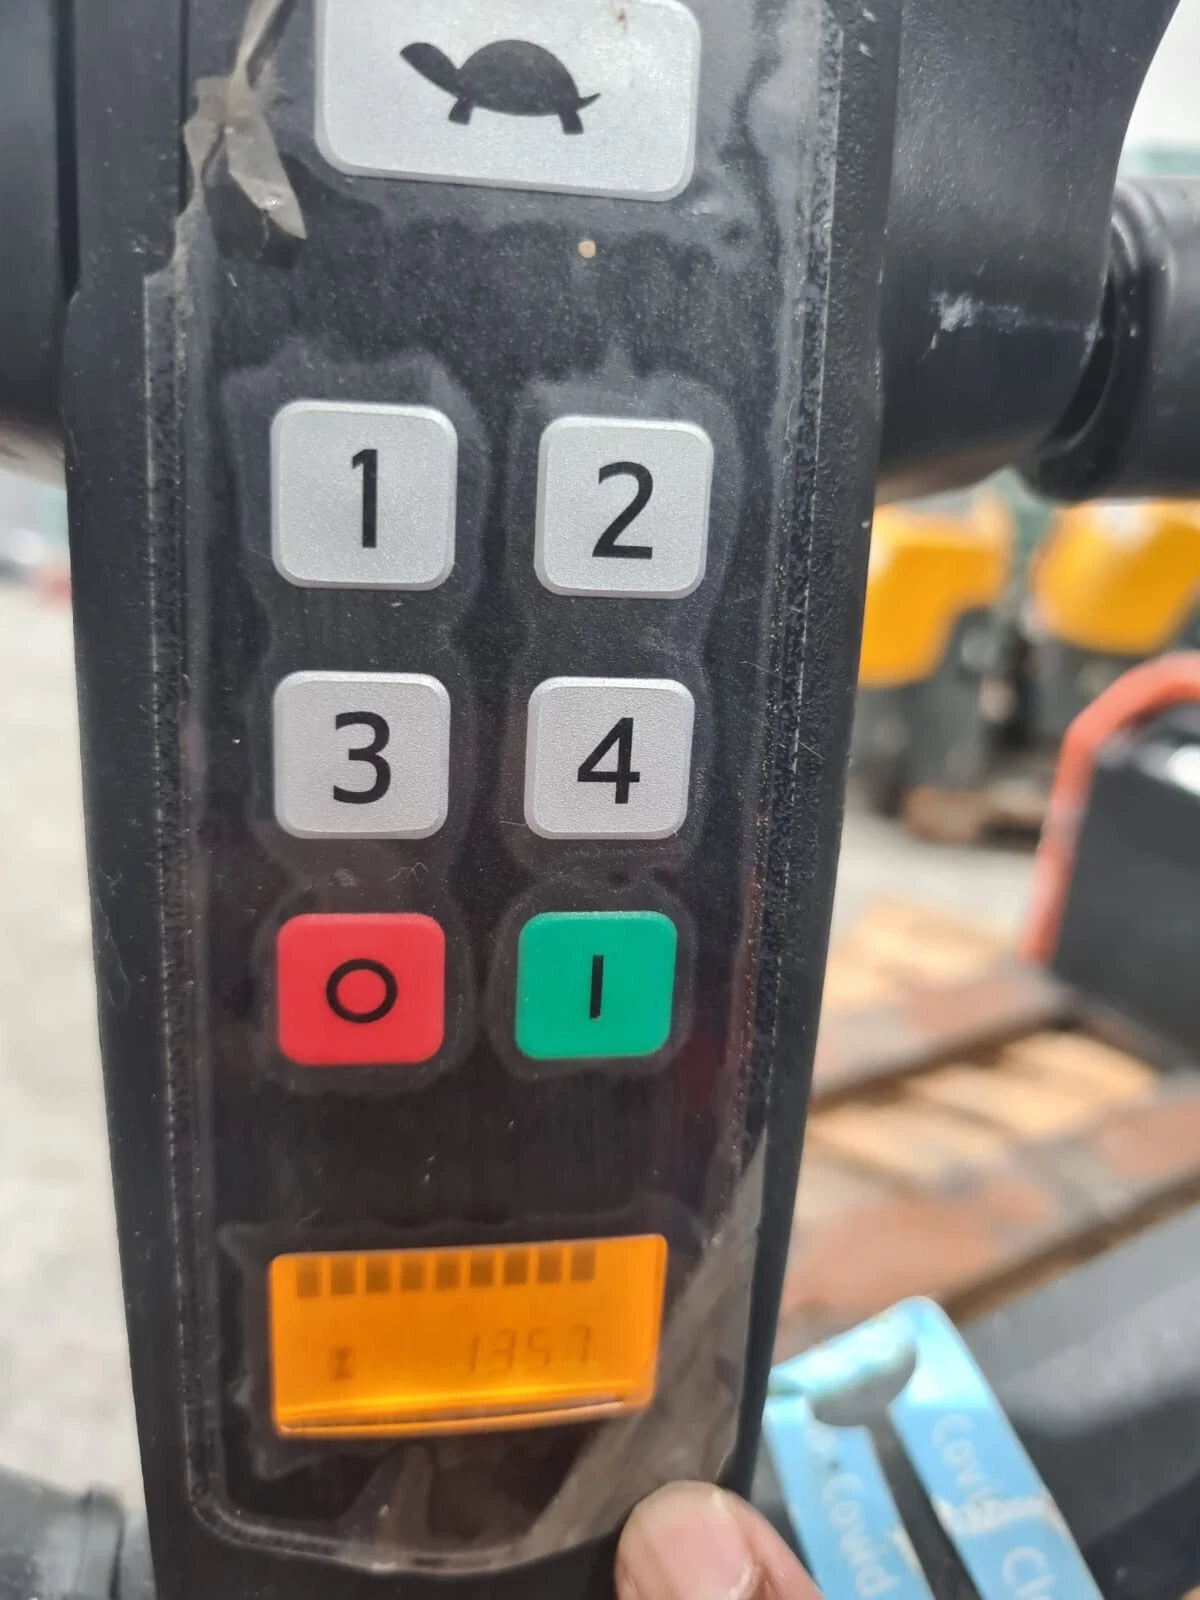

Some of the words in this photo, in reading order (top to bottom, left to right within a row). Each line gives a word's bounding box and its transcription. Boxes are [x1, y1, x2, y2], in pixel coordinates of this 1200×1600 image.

[352, 448, 378, 548] 1
[592, 461, 654, 560] 2
[333, 711, 391, 804] 3
[577, 717, 640, 804] 4
[467, 1325, 593, 1374] 1357
[931, 1413, 1014, 1532] Covi
[822, 1473, 902, 1598] Covid
